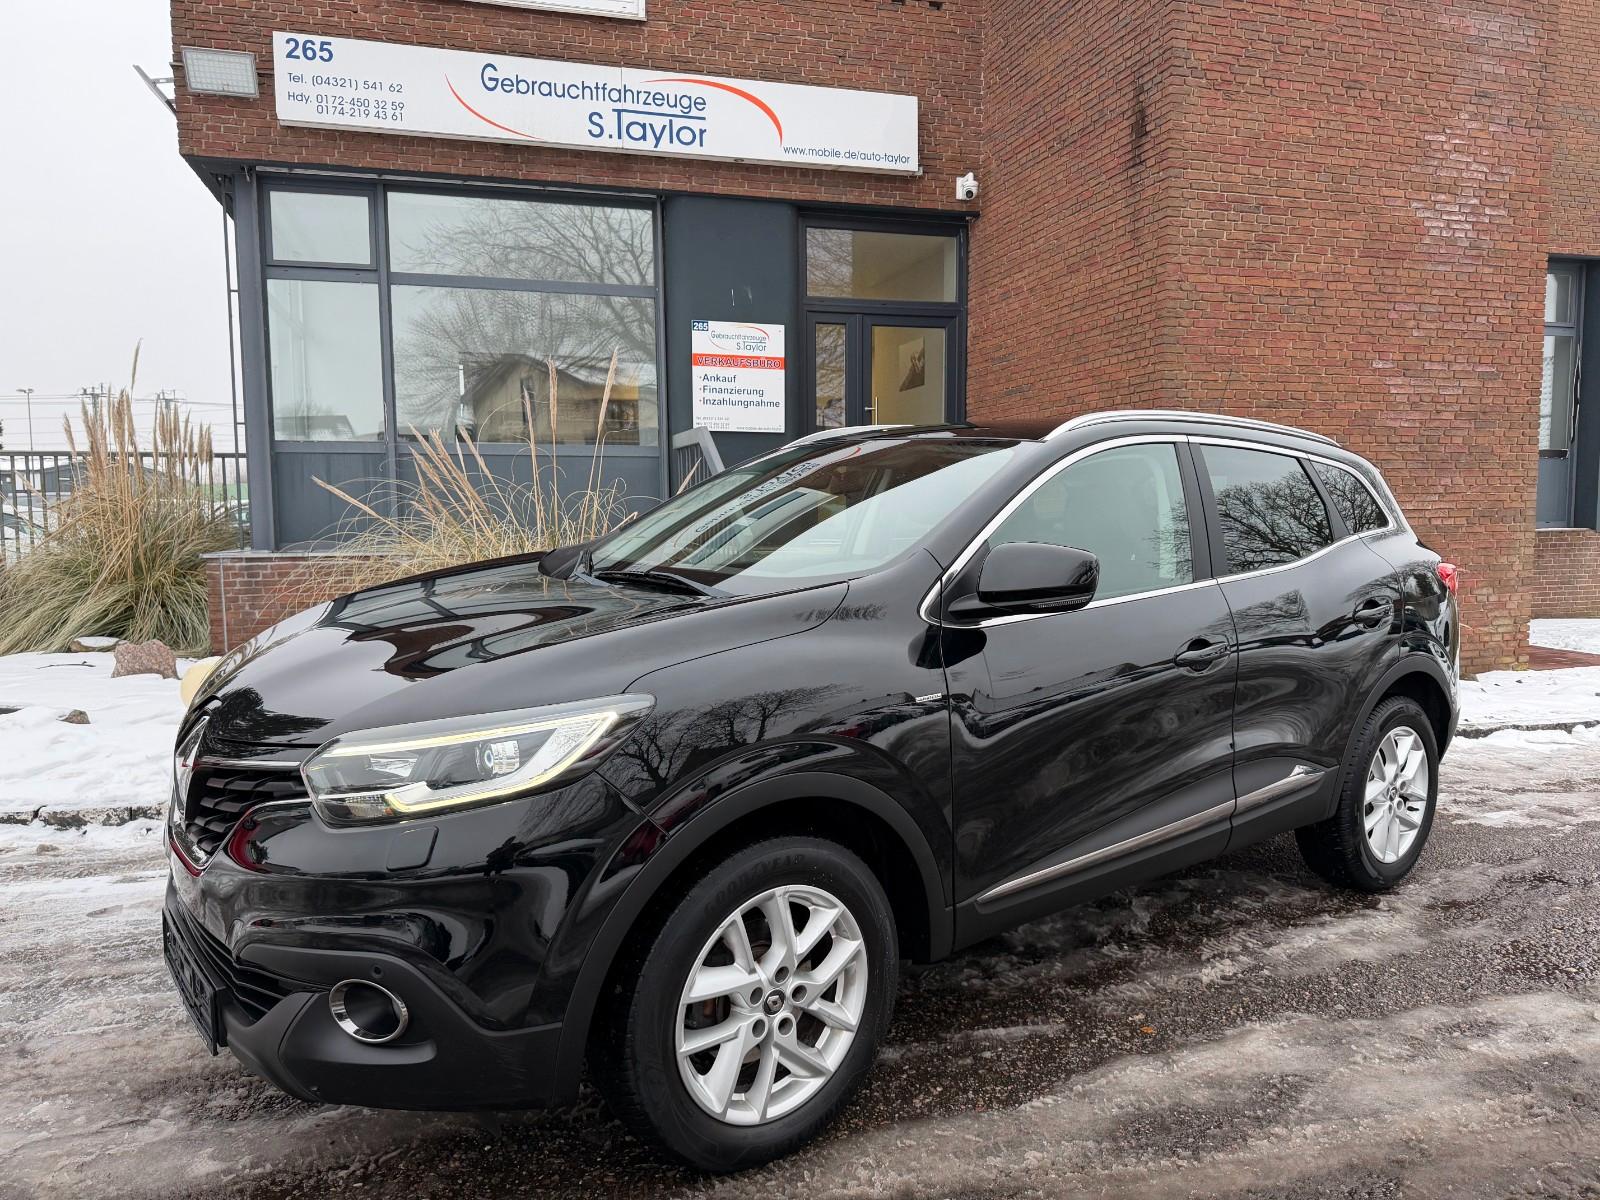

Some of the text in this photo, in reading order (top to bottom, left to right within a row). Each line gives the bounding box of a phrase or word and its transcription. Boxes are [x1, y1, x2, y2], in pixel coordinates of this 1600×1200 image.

[285, 37, 334, 62] 265
[287, 72, 403, 93] Tel. (04321) 541 62
[480, 62, 707, 114] Gebrauchtfahrzeuge
[287, 91, 405, 111] Hdy. 0172-450 32 59
[316, 104, 404, 122] 0174-219 43 61
[587, 108, 707, 149] S.Taylor
[783, 146, 910, 165] www.mobile.de/auto-taylor
[693, 322, 708, 331] 265
[736, 340, 767, 353] S.Taylor
[697, 356, 781, 368] VERKAUFSBÜRO
[702, 373, 737, 383] Ankauf
[702, 385, 764, 398] Finanzierung
[702, 397, 780, 408] Inzahlungnahme
